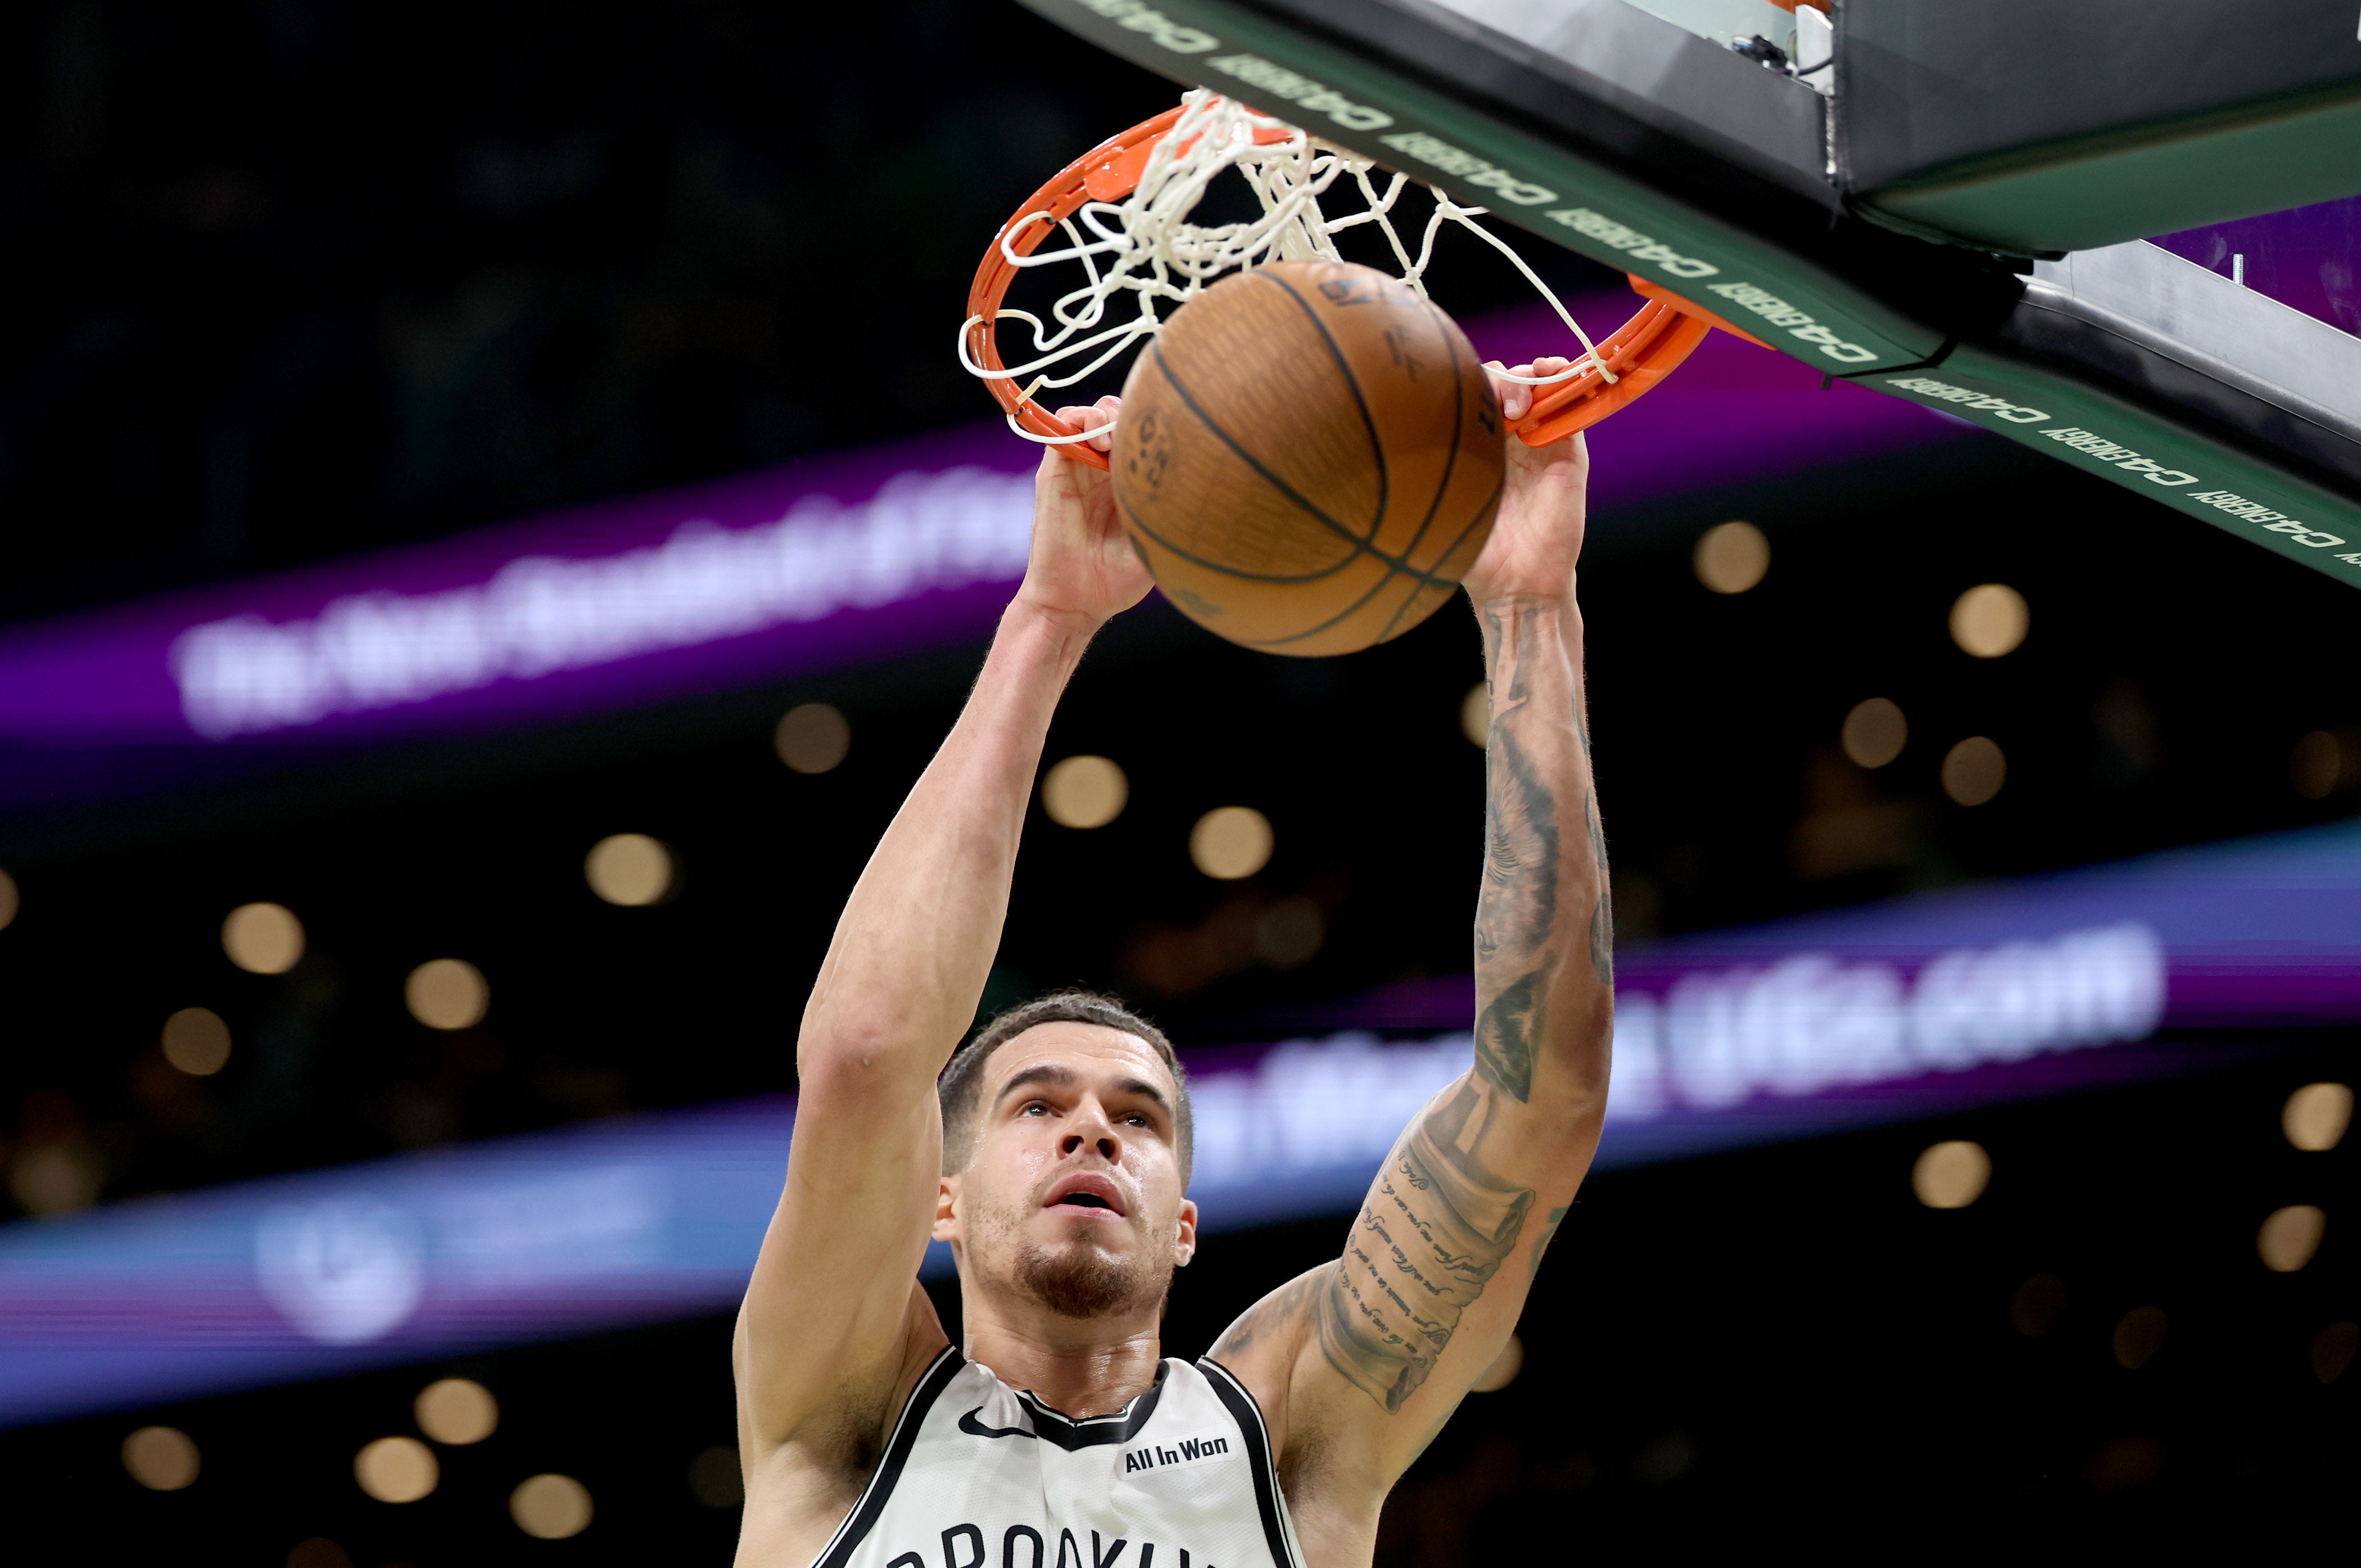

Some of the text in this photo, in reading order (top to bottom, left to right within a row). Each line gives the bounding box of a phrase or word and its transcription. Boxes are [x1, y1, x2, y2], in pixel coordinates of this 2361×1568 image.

[1788, 324, 1878, 362] C4
[1965, 398, 2051, 423] C4
[2038, 427, 2199, 486] C4 ENERGY
[2186, 490, 2346, 548] C4 ENERGY
[1126, 1438, 1228, 1473] All In Won
